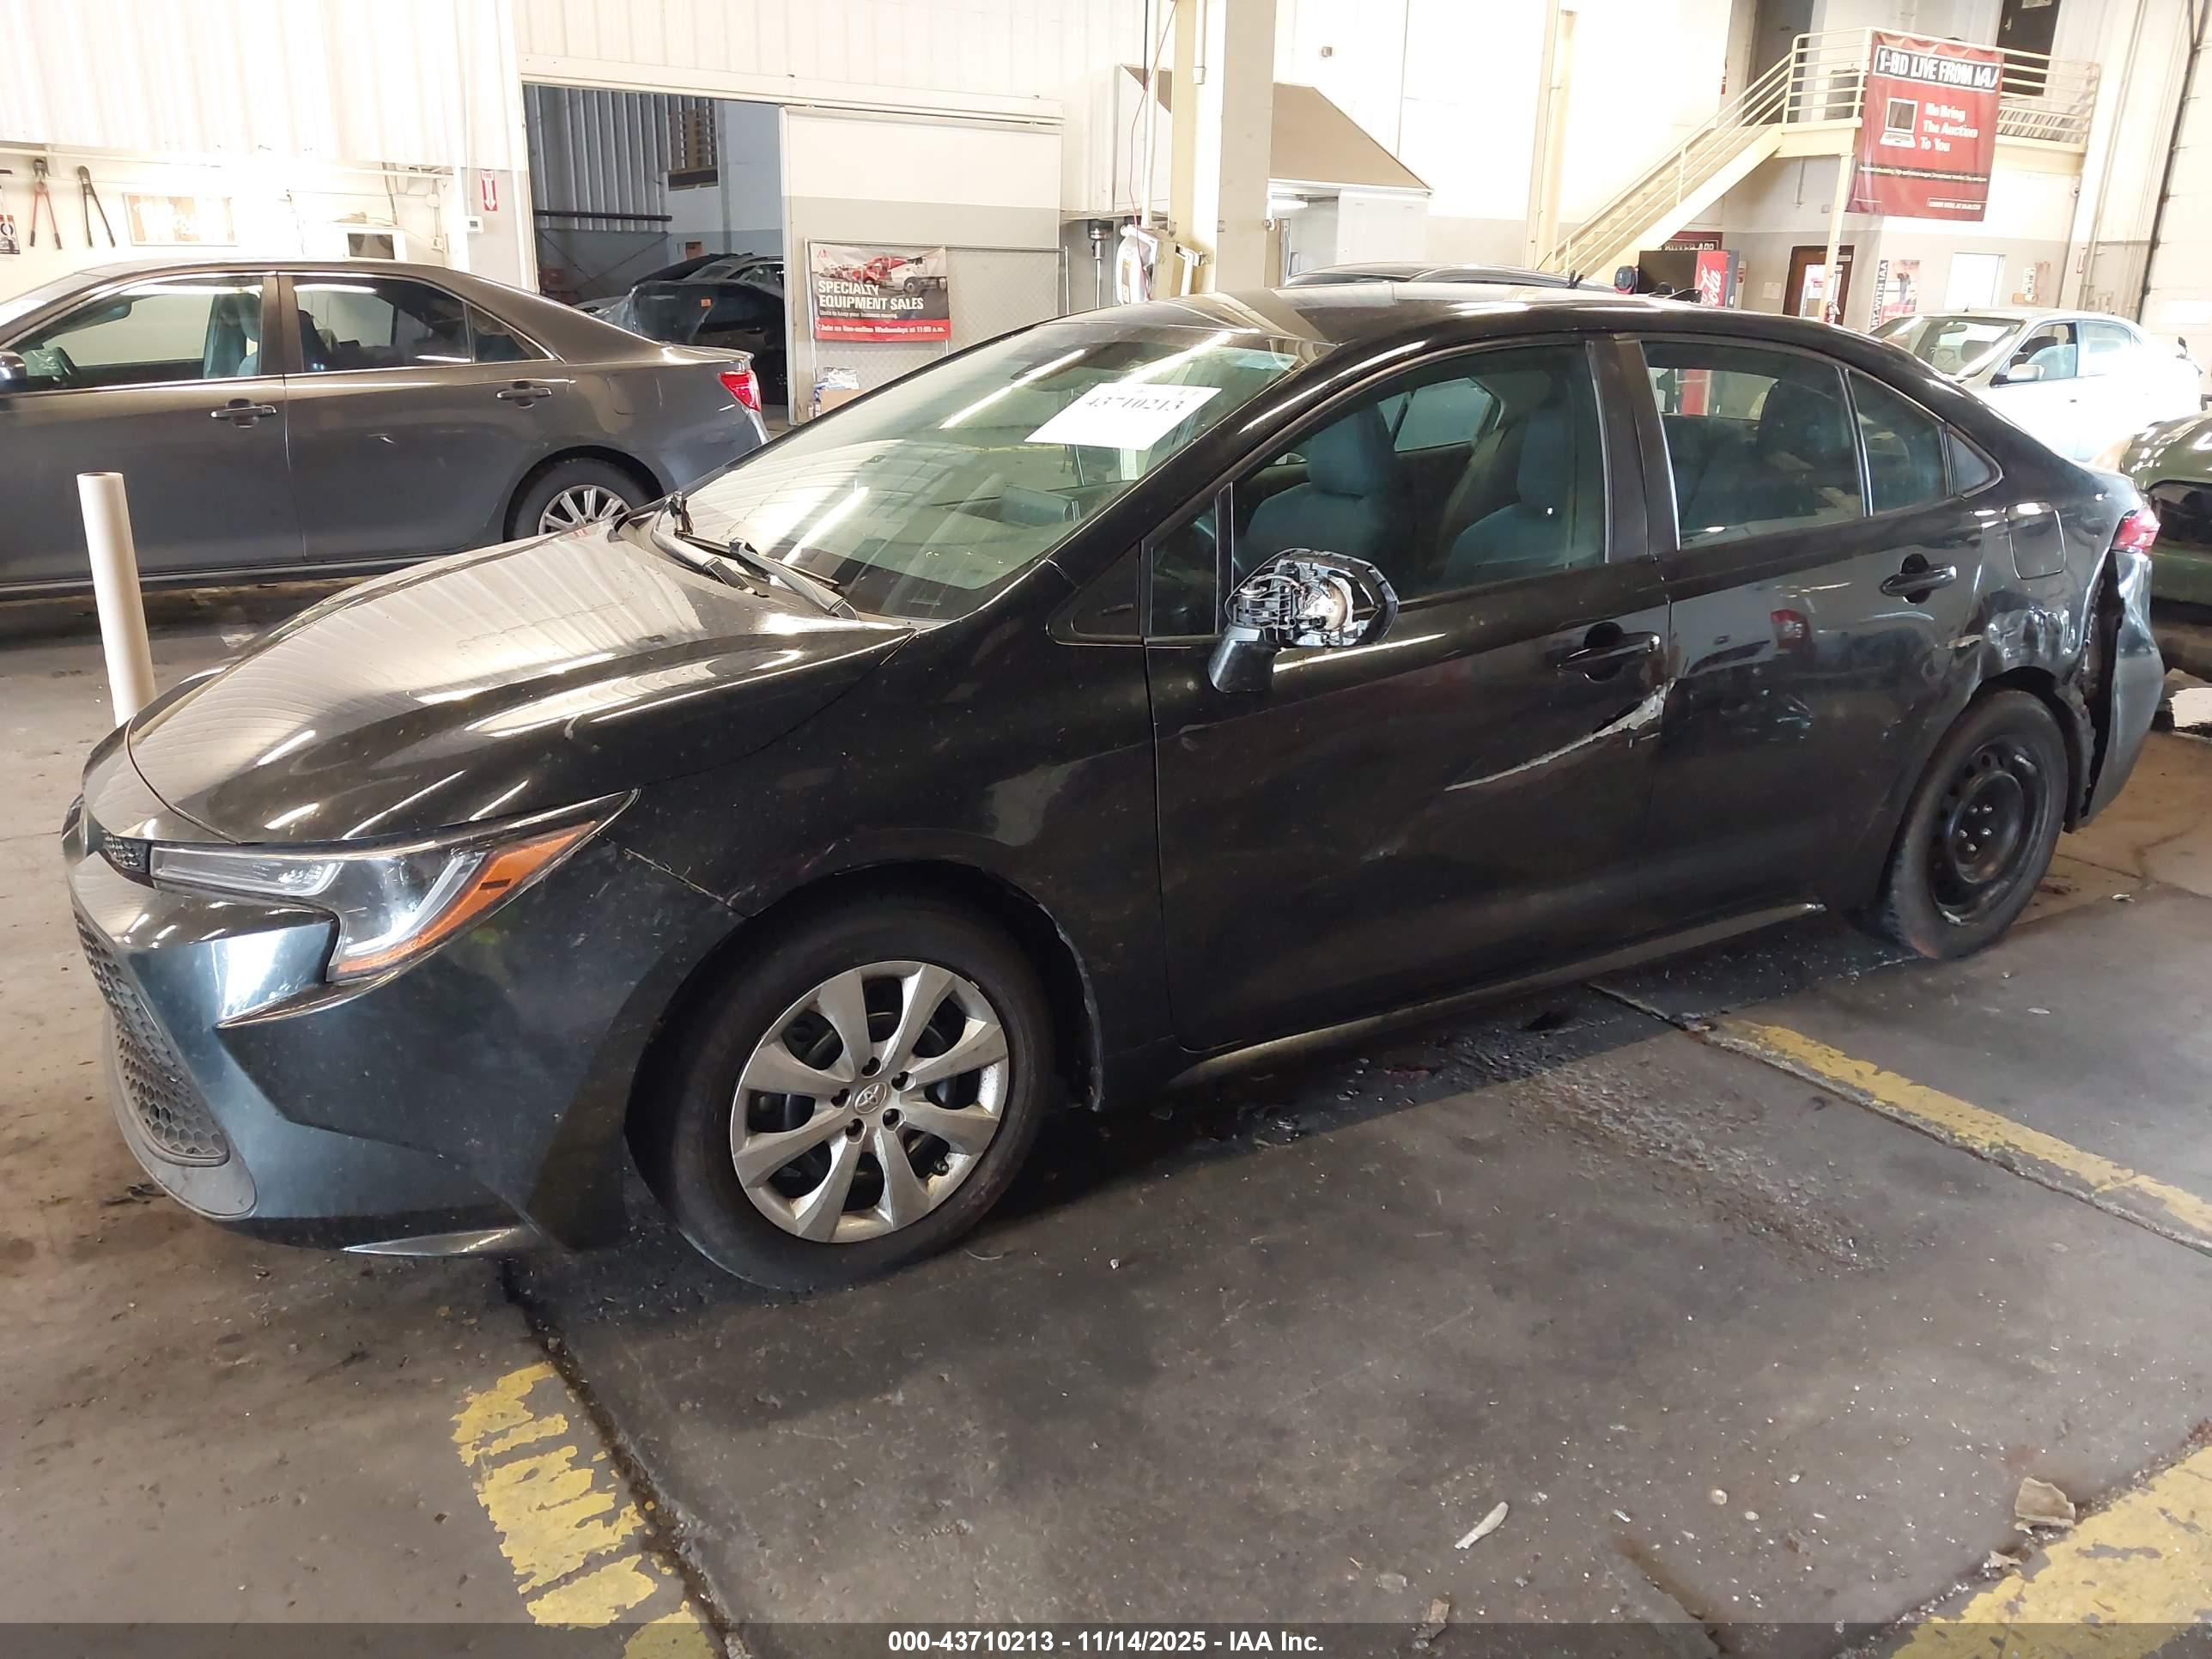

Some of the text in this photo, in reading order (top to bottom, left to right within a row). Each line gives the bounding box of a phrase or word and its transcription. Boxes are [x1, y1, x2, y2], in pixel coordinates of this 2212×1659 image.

[1911, 57, 1938, 80] LIVE
[1938, 60, 1974, 85] FROM
[1940, 104, 1966, 123] Bring
[1922, 119, 1978, 138] The Auction
[1920, 136, 1951, 152] To You
[817, 280, 879, 296] SPECIALTY
[818, 295, 924, 310] EQUIPMENT SALES
